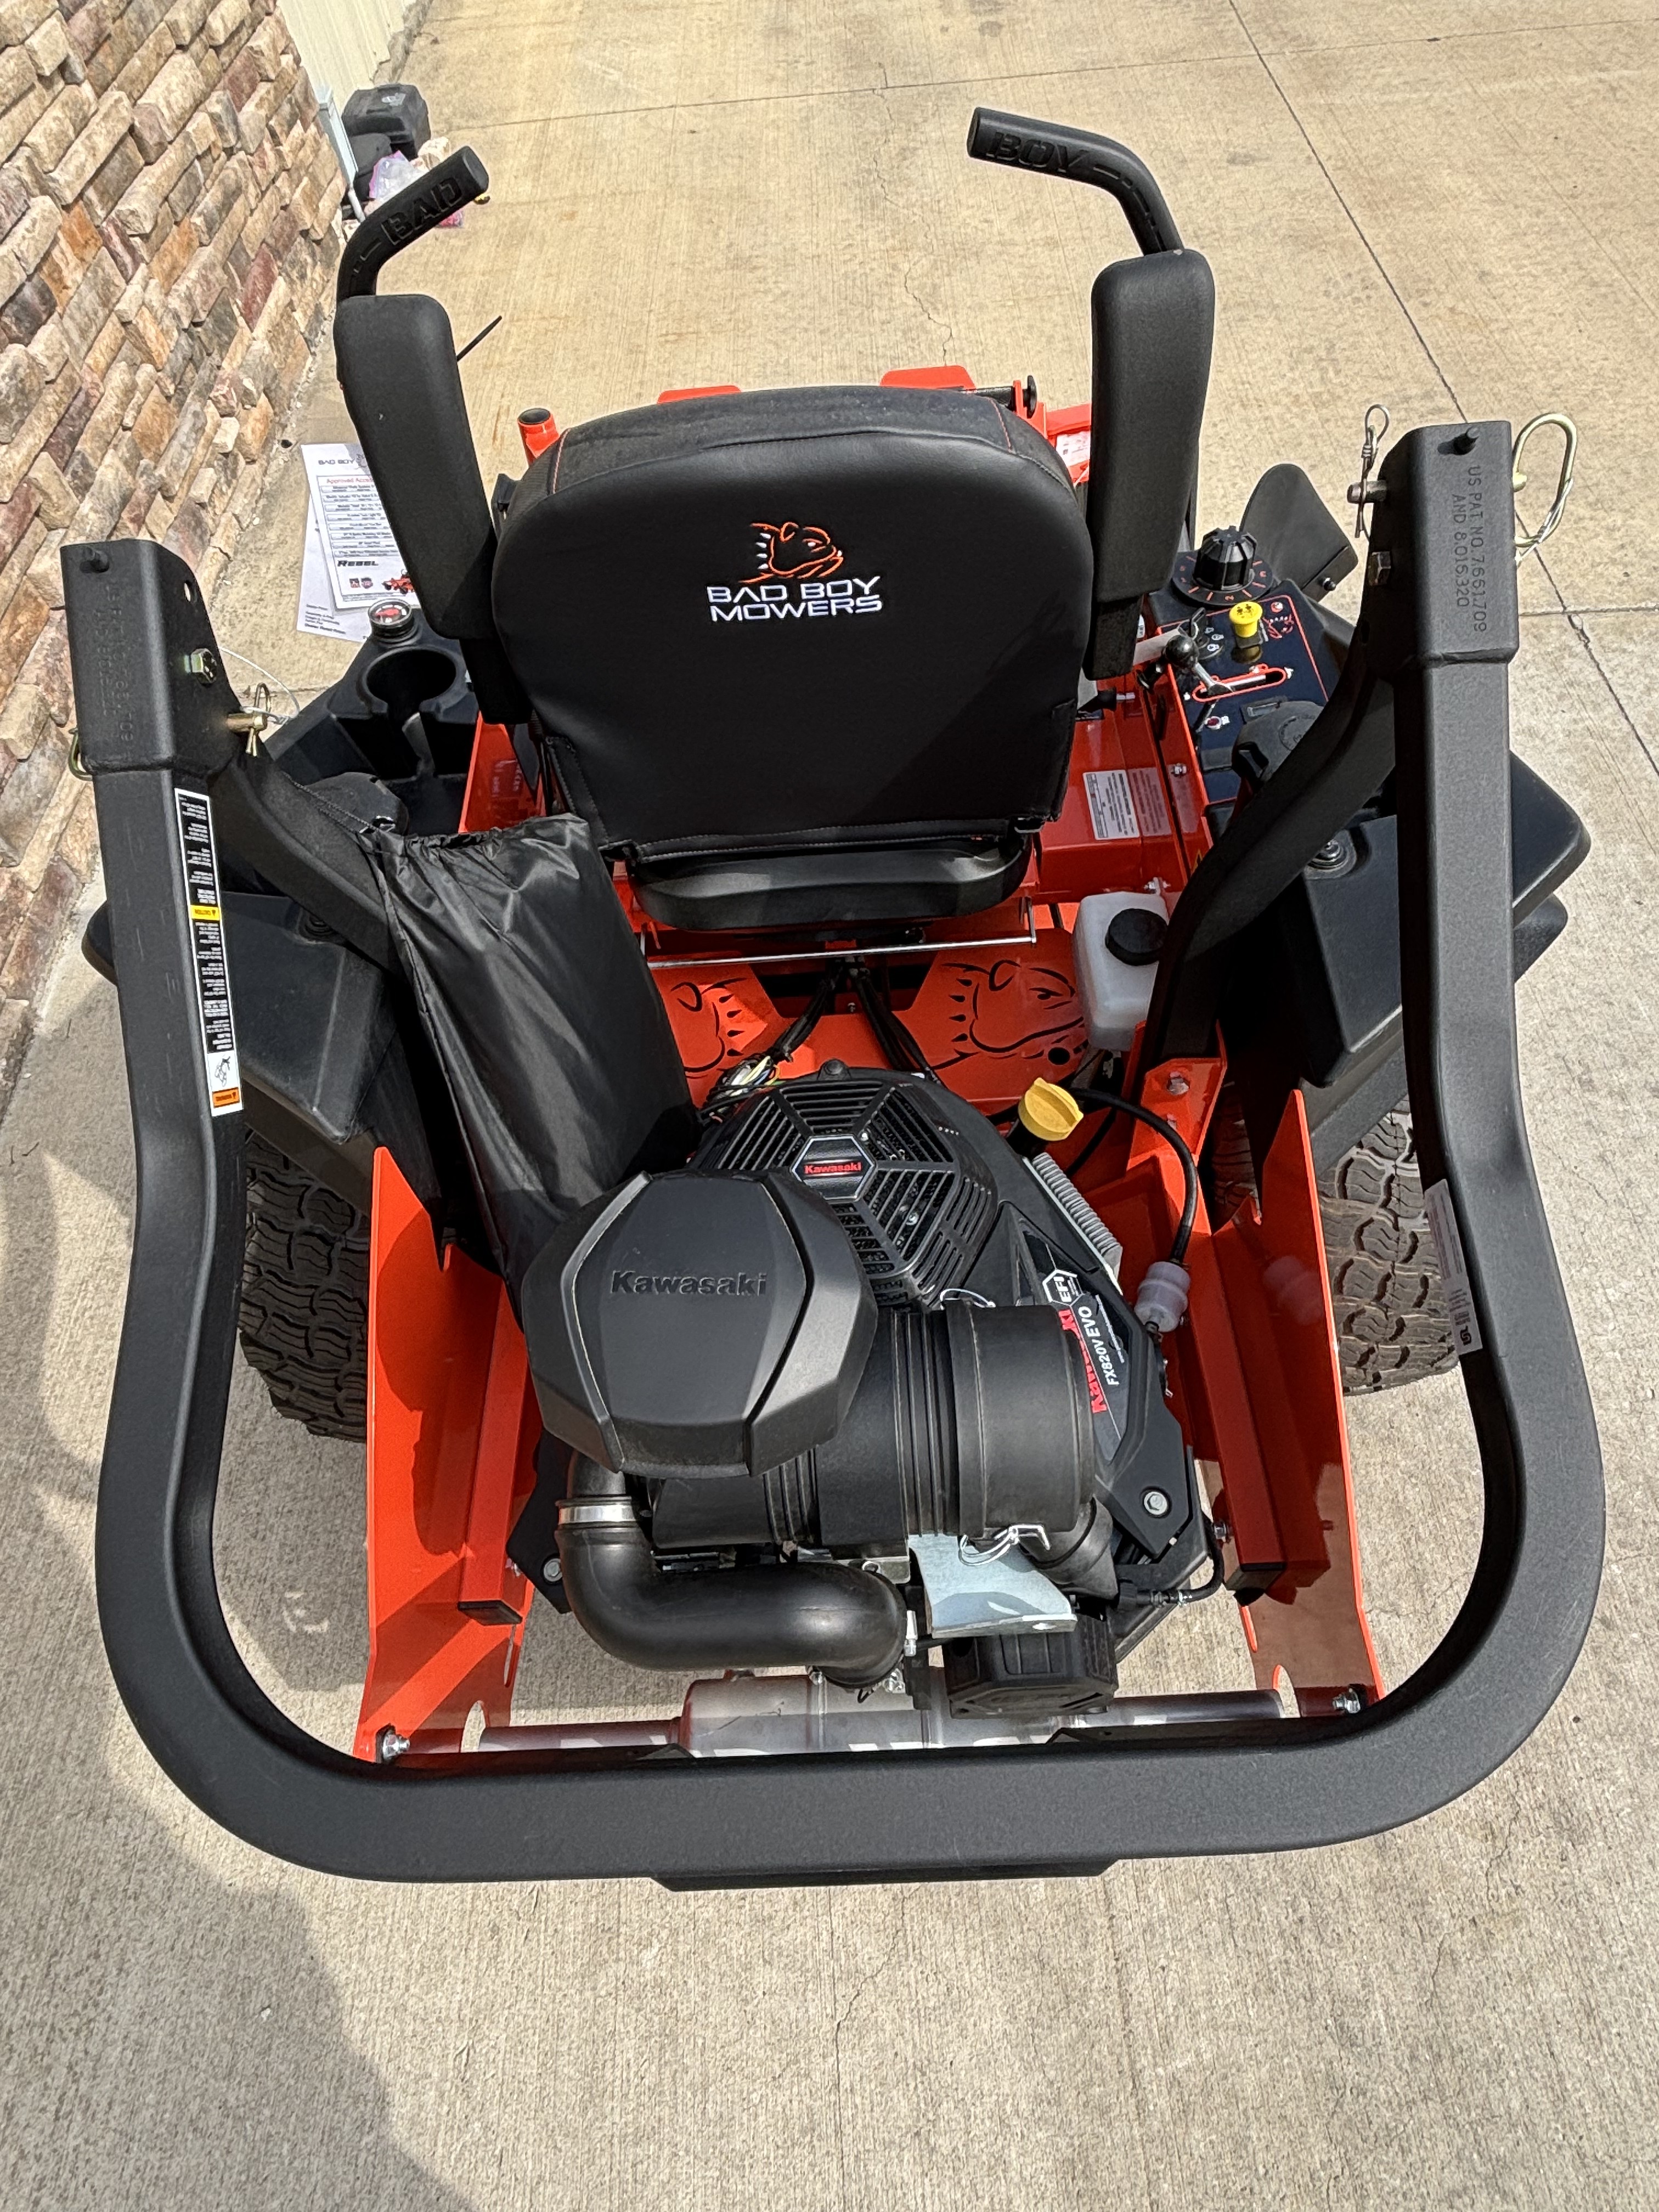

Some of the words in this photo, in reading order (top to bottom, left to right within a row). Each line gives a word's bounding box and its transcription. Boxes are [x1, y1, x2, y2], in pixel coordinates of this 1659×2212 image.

[985, 131, 1090, 173] BOY
[381, 176, 462, 245] BAD
[1468, 465, 1481, 486] US
[1452, 494, 1466, 523] AND
[707, 584, 788, 604] BAD
[800, 575, 881, 600] BOY
[709, 594, 883, 622] MOWERS
[804, 1161, 862, 1174] Kawasaki
[610, 1269, 767, 1296] Kawasaki
[1053, 1276, 1072, 1303] EFI
[1077, 1306, 1101, 1338] EVO
[1091, 1339, 1120, 1386] FX820V
